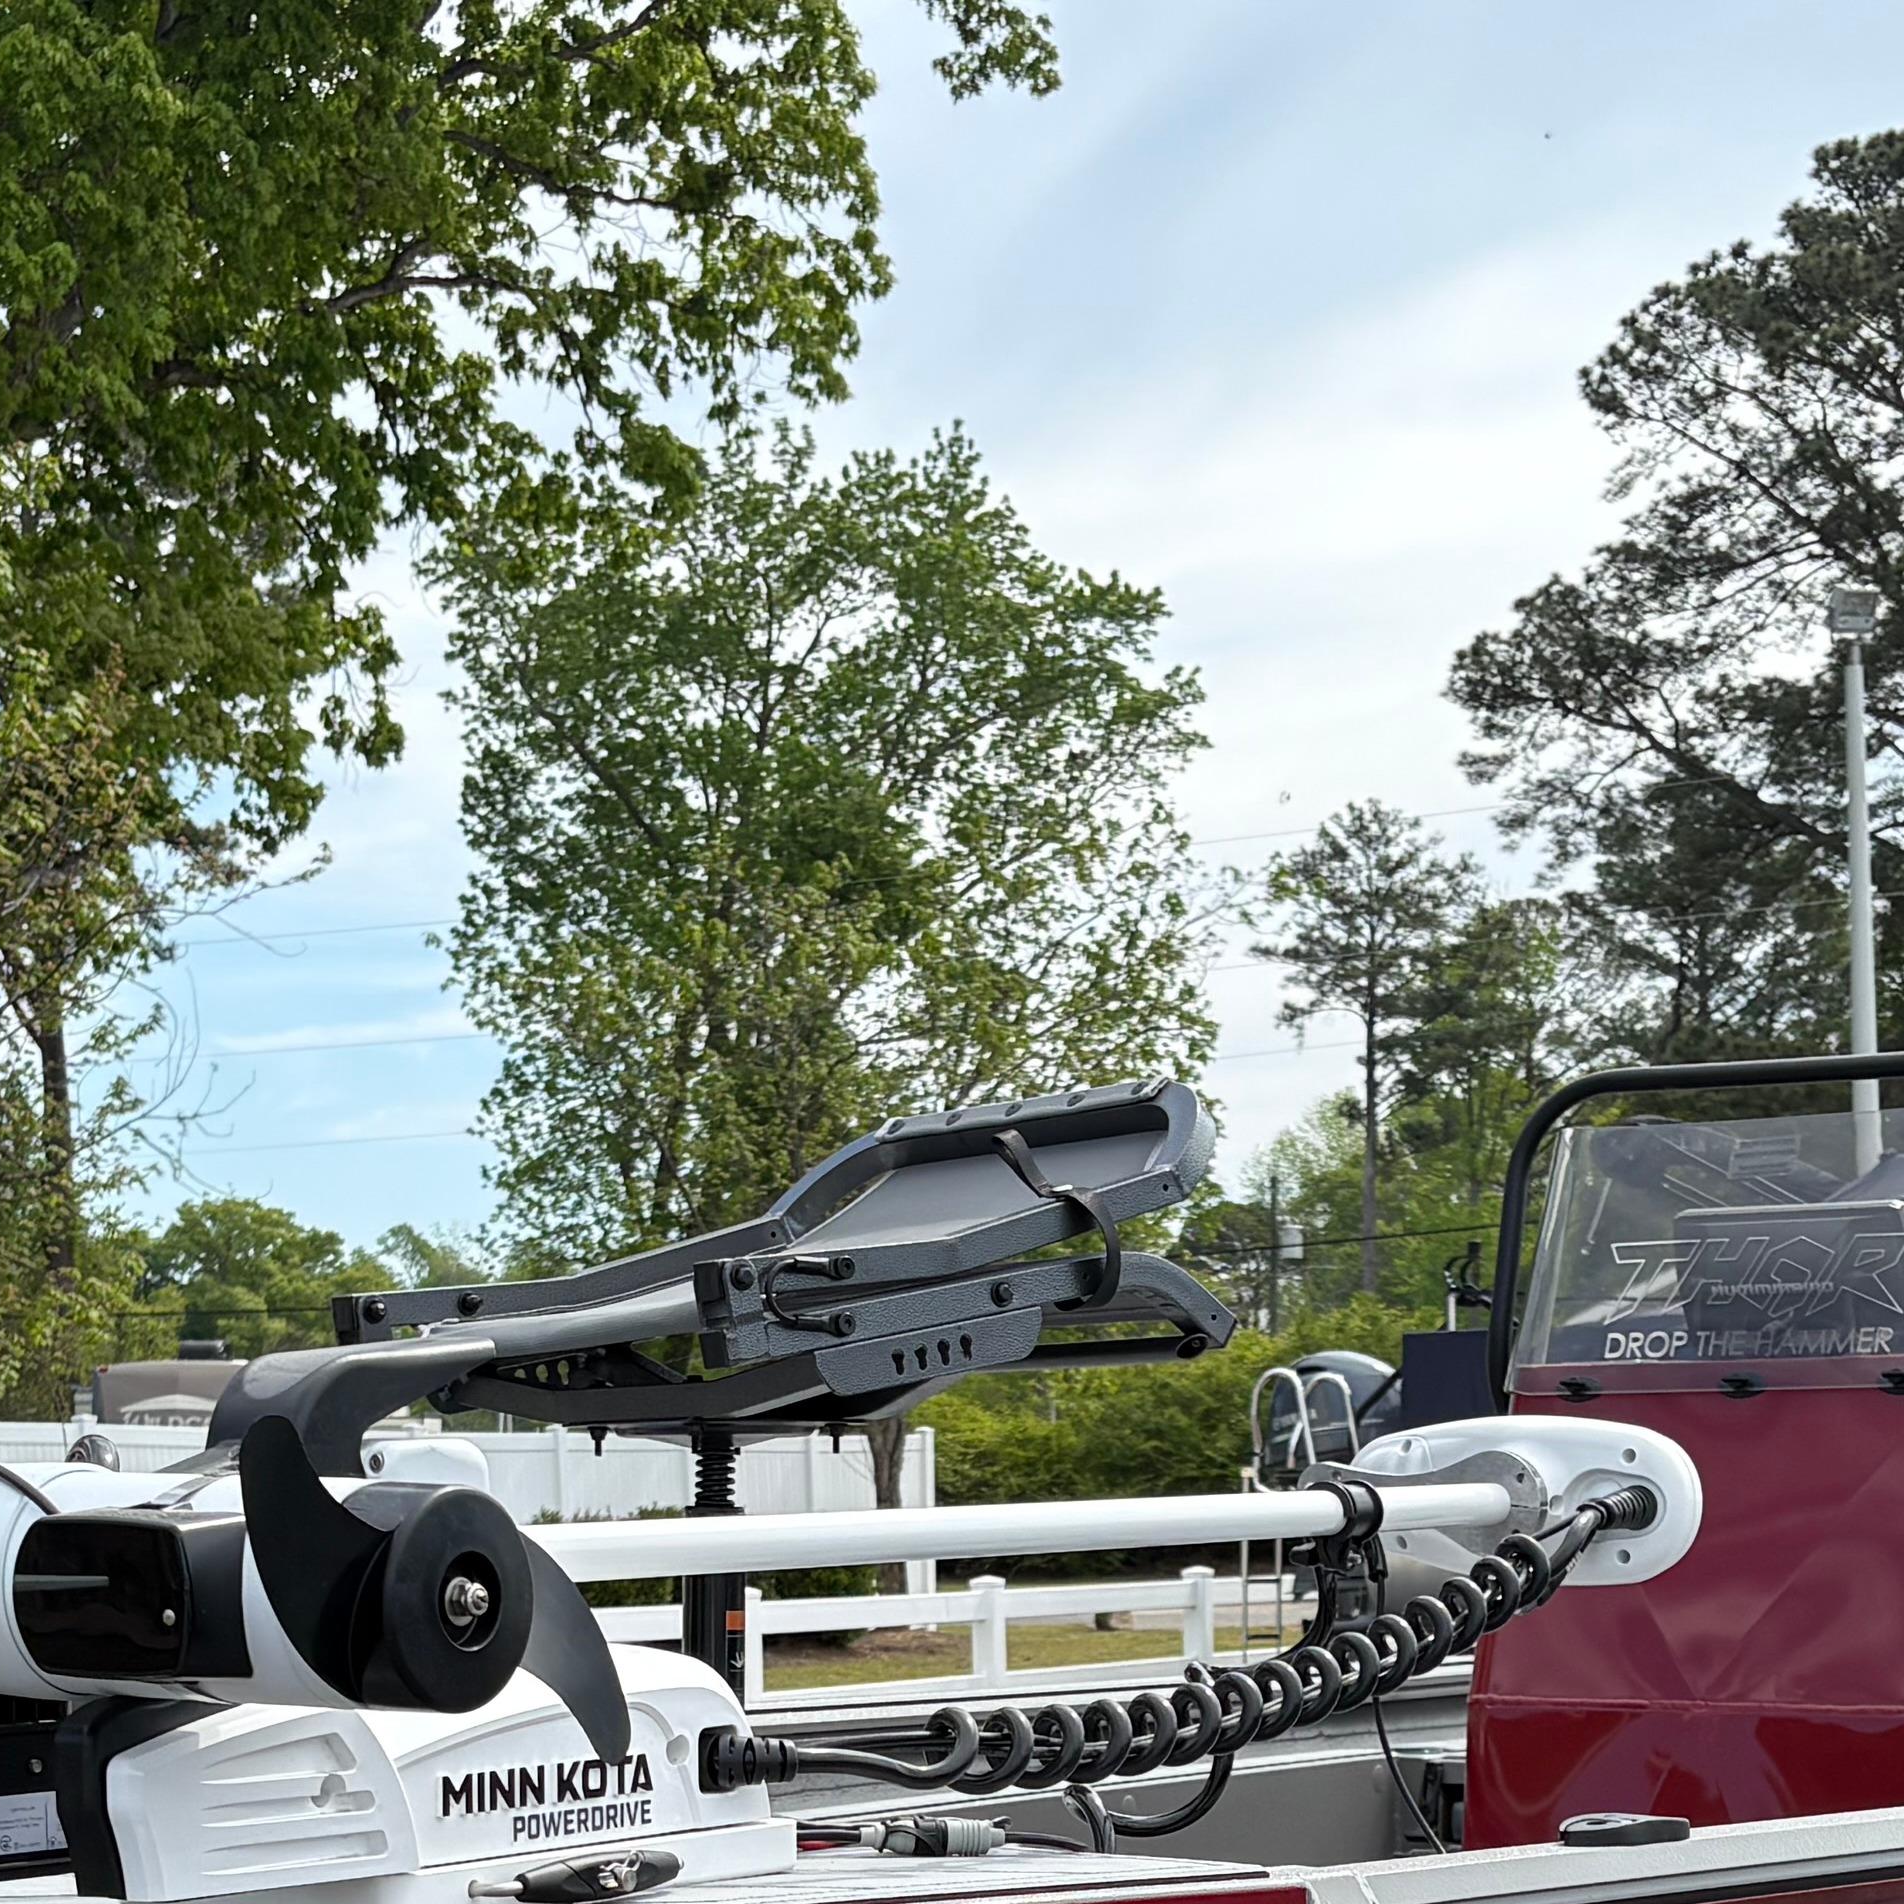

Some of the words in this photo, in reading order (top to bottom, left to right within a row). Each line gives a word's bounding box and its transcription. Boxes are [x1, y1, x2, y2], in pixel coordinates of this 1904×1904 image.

[1603, 1330, 1689, 1359] DROP
[1696, 1329, 1747, 1356] THE
[1754, 1326, 1895, 1357] HAMMER
[441, 1764, 546, 1819] MINN
[556, 1753, 654, 1799] KOTA
[512, 1799, 653, 1843] POWERDRIVE
